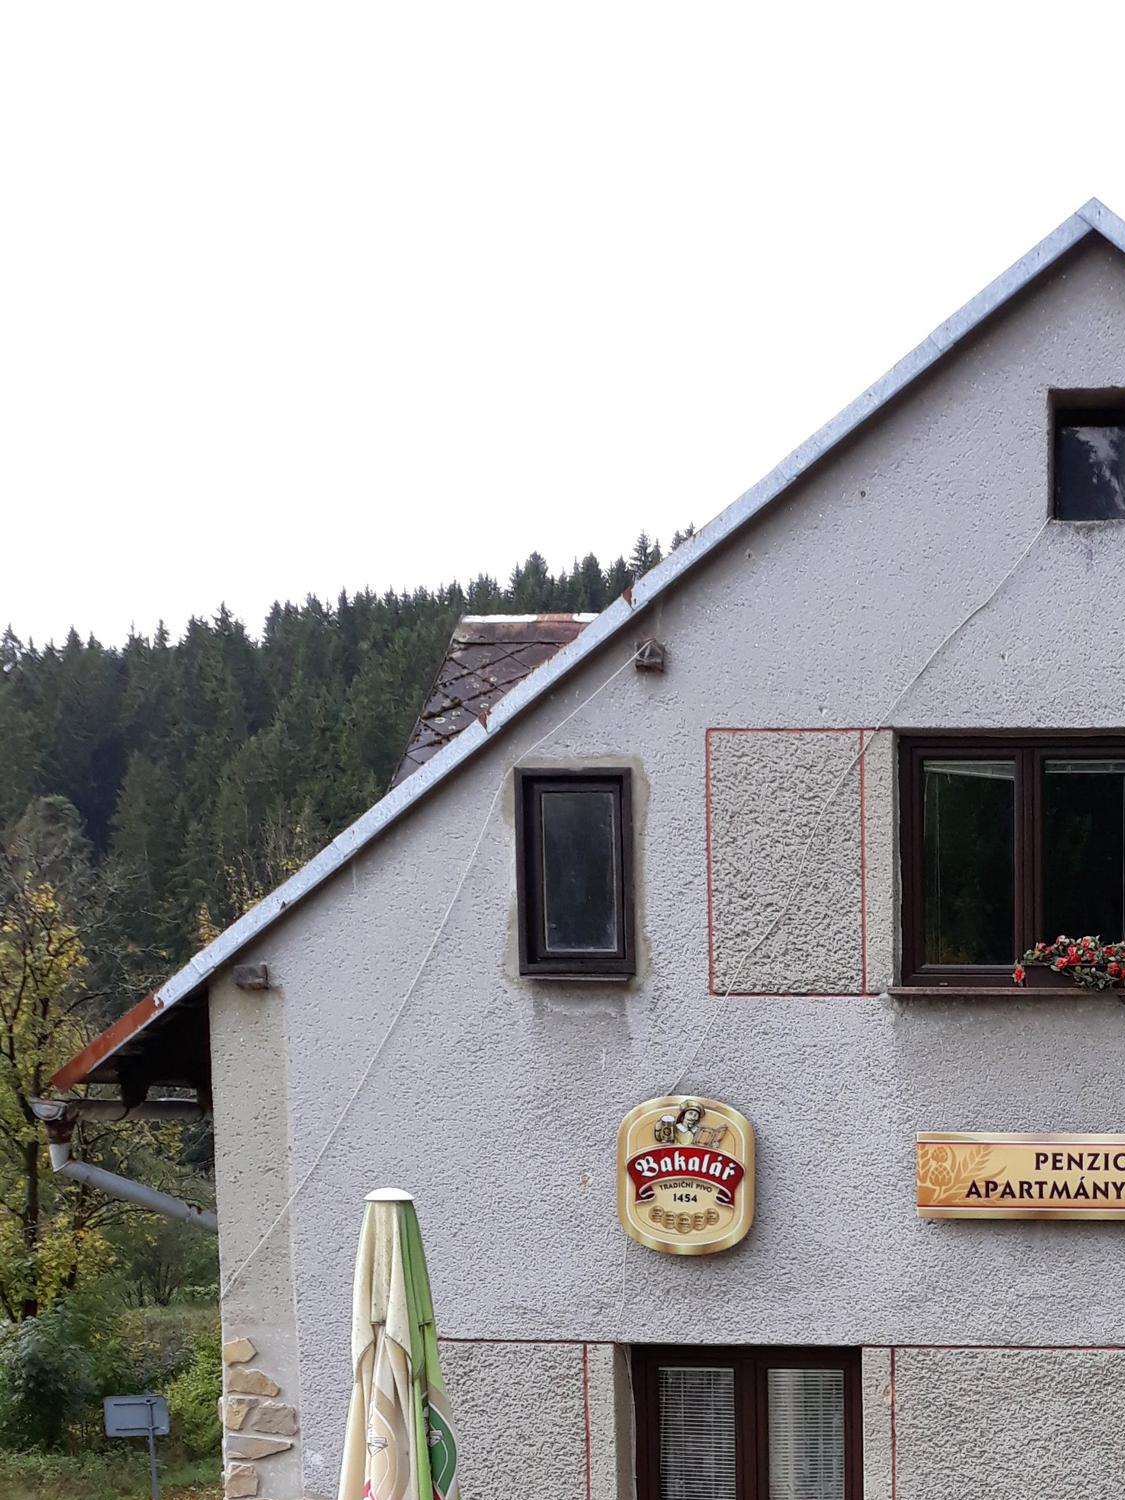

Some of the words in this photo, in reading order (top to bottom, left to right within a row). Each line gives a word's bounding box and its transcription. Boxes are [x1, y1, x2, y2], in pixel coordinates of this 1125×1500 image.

[635, 1150, 737, 1181] Bakalář
[659, 1180, 695, 1192] TRADIČNÍ
[696, 1181, 713, 1193] PIVO
[965, 1176, 1125, 1201] APARTMÁNY
[673, 1193, 698, 1203] 1454
